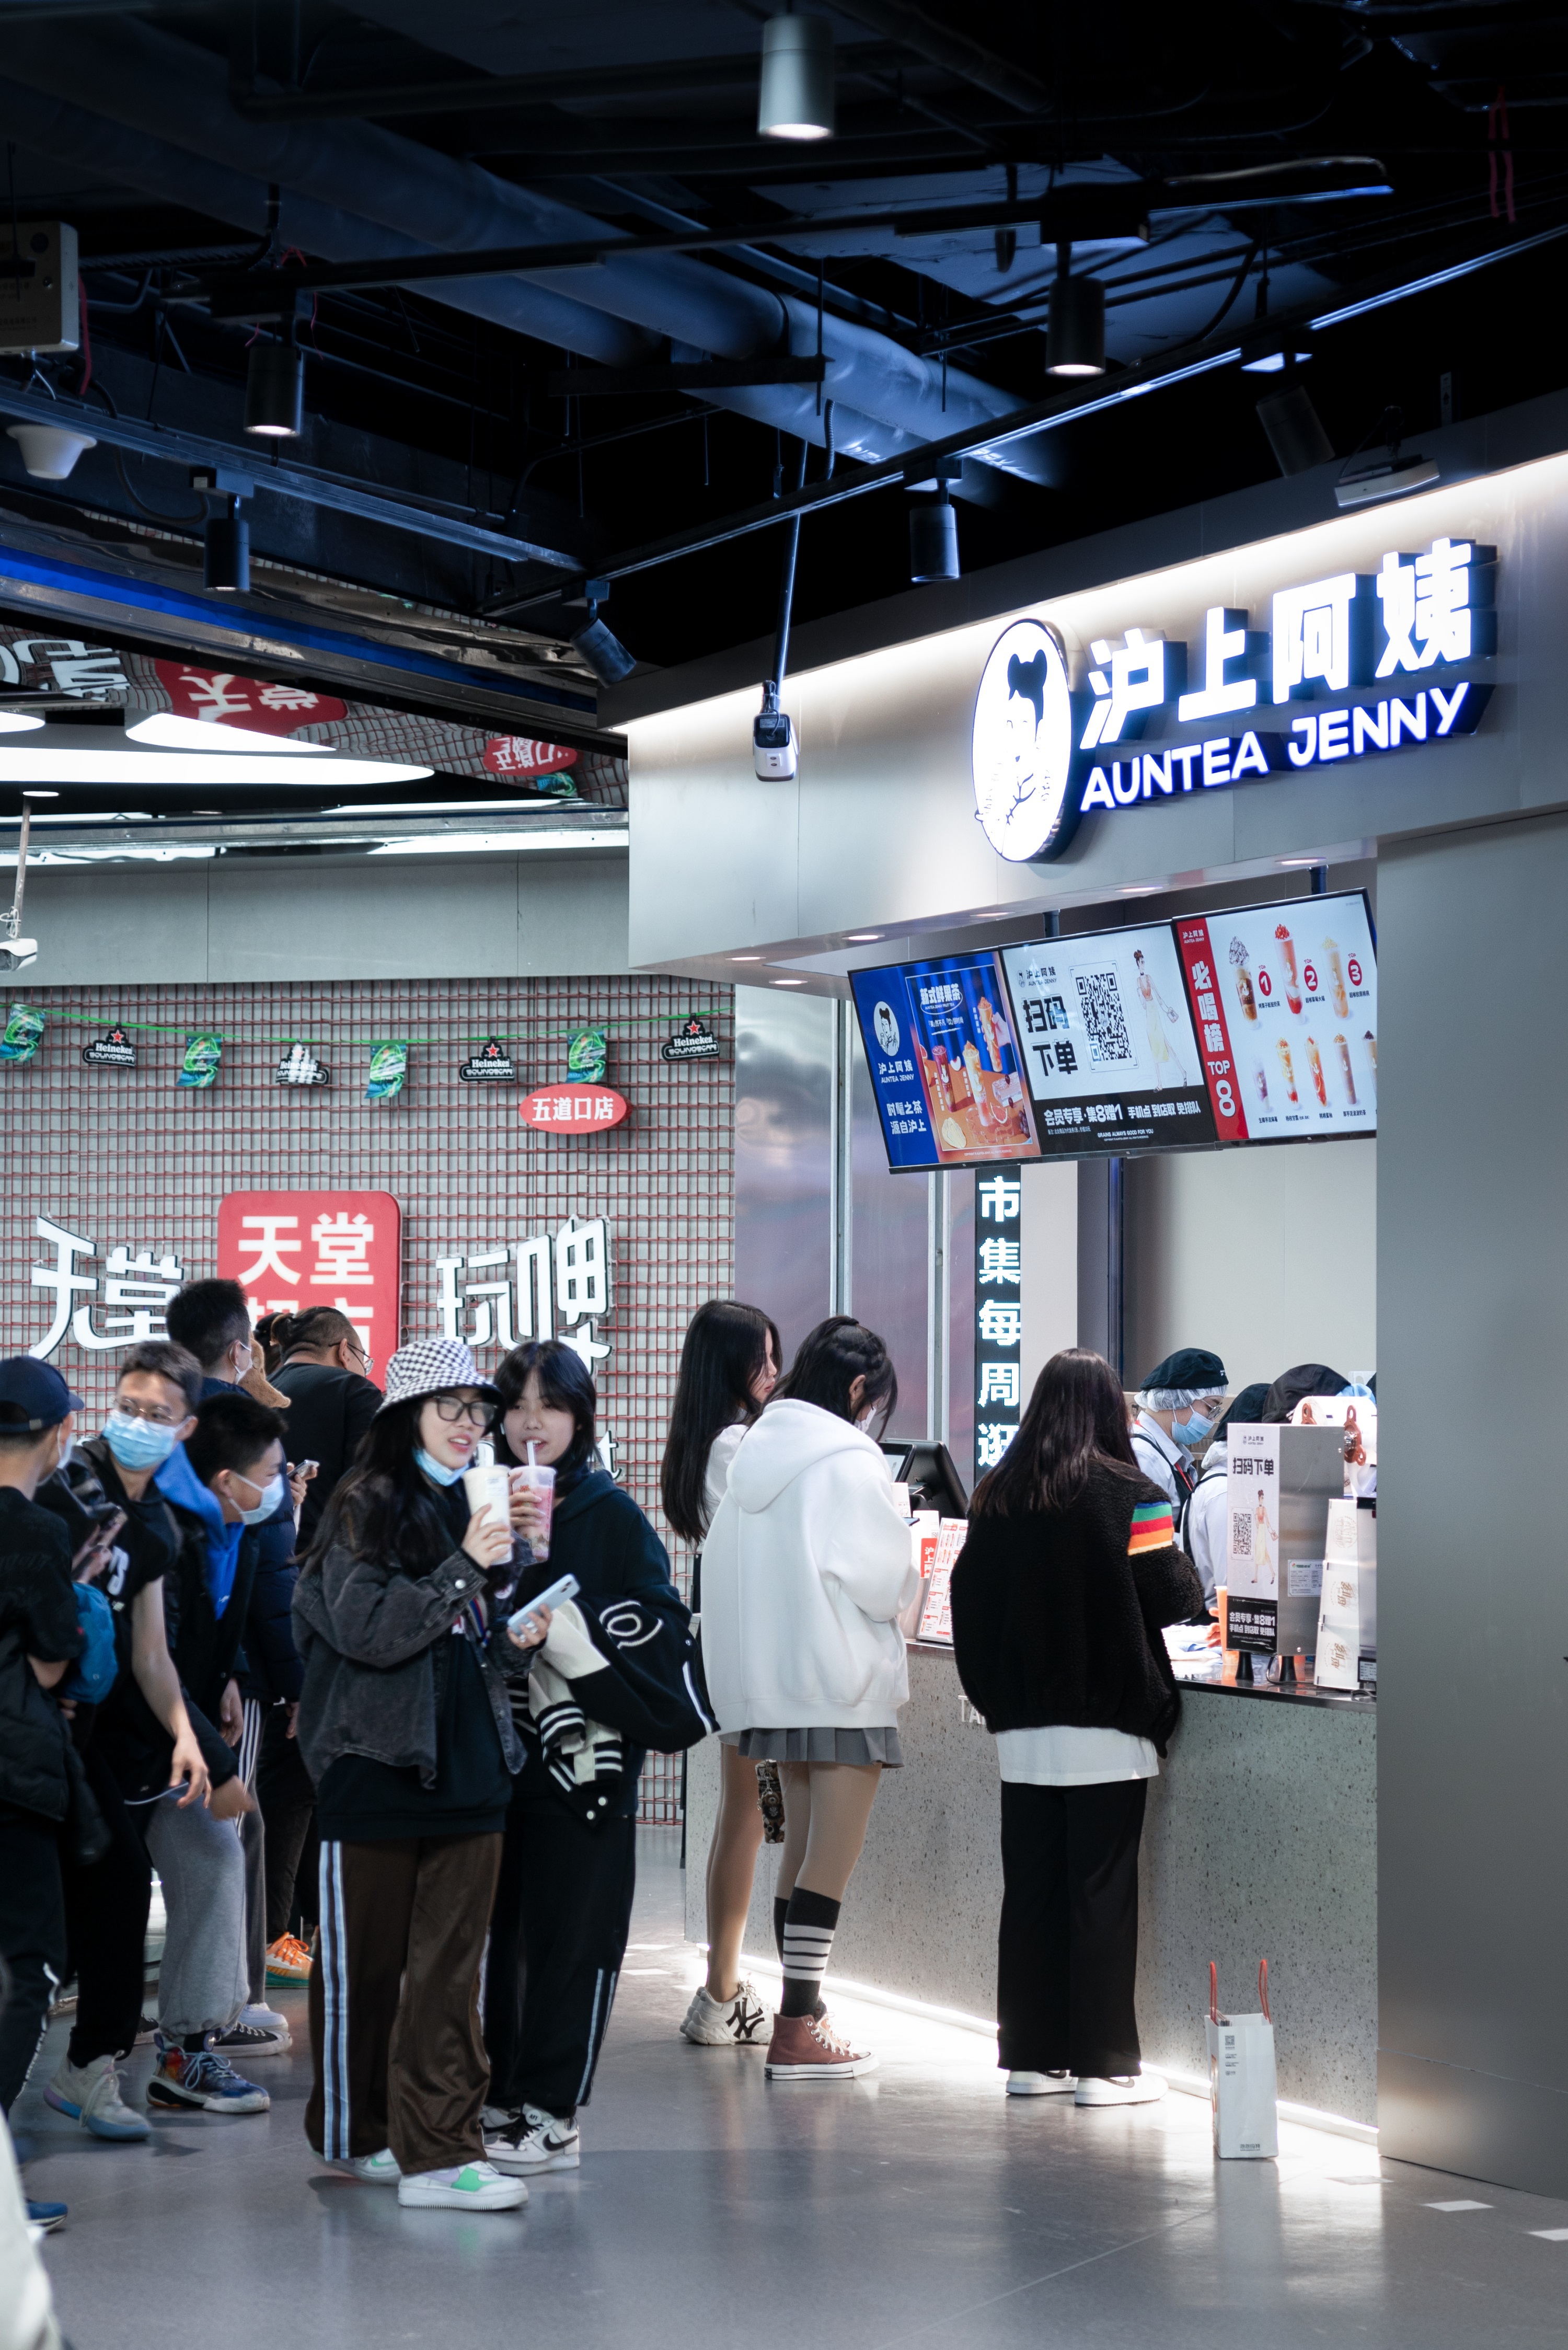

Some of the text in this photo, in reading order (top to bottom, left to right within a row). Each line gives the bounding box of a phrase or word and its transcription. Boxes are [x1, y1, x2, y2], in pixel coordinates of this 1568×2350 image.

[1080, 537, 1472, 750] 沪上阿姨
[1080, 682, 1470, 812] AUNTEA JENNY
[1026, 966, 1056, 979] 沪上阿姨
[1306, 970, 1317, 986] 2
[1350, 964, 1361, 981] 3
[1261, 975, 1269, 991] 1
[920, 983, 961, 1005] 新式鲜果茶
[1022, 995, 1070, 1033] 扫码
[673, 1036, 713, 1047] Heineken
[1192, 961, 1236, 1117] 必喝榜 TOP 8
[95, 1043, 133, 1054] Heineken
[280, 1061, 318, 1072] Heineken
[471, 1058, 510, 1068] Heineken
[878, 1059, 914, 1075] 沪上阿姨
[1032, 1040, 1078, 1077] 下单
[532, 1096, 613, 1122] 五道口店
[886, 1100, 923, 1116] 时髦之茶
[1127, 1105, 1152, 1119] 手机点
[1151, 1102, 1176, 1118] 到店取
[1176, 1101, 1201, 1115] 免排队
[890, 1119, 927, 1134] 源自沪上
[237, 1212, 374, 1286] 天堂
[1233, 1457, 1274, 1476] 扫码下单
[1229, 1623, 1275, 1637] 手机点 到店取 免排队
[725, 1997, 765, 2039] NY
